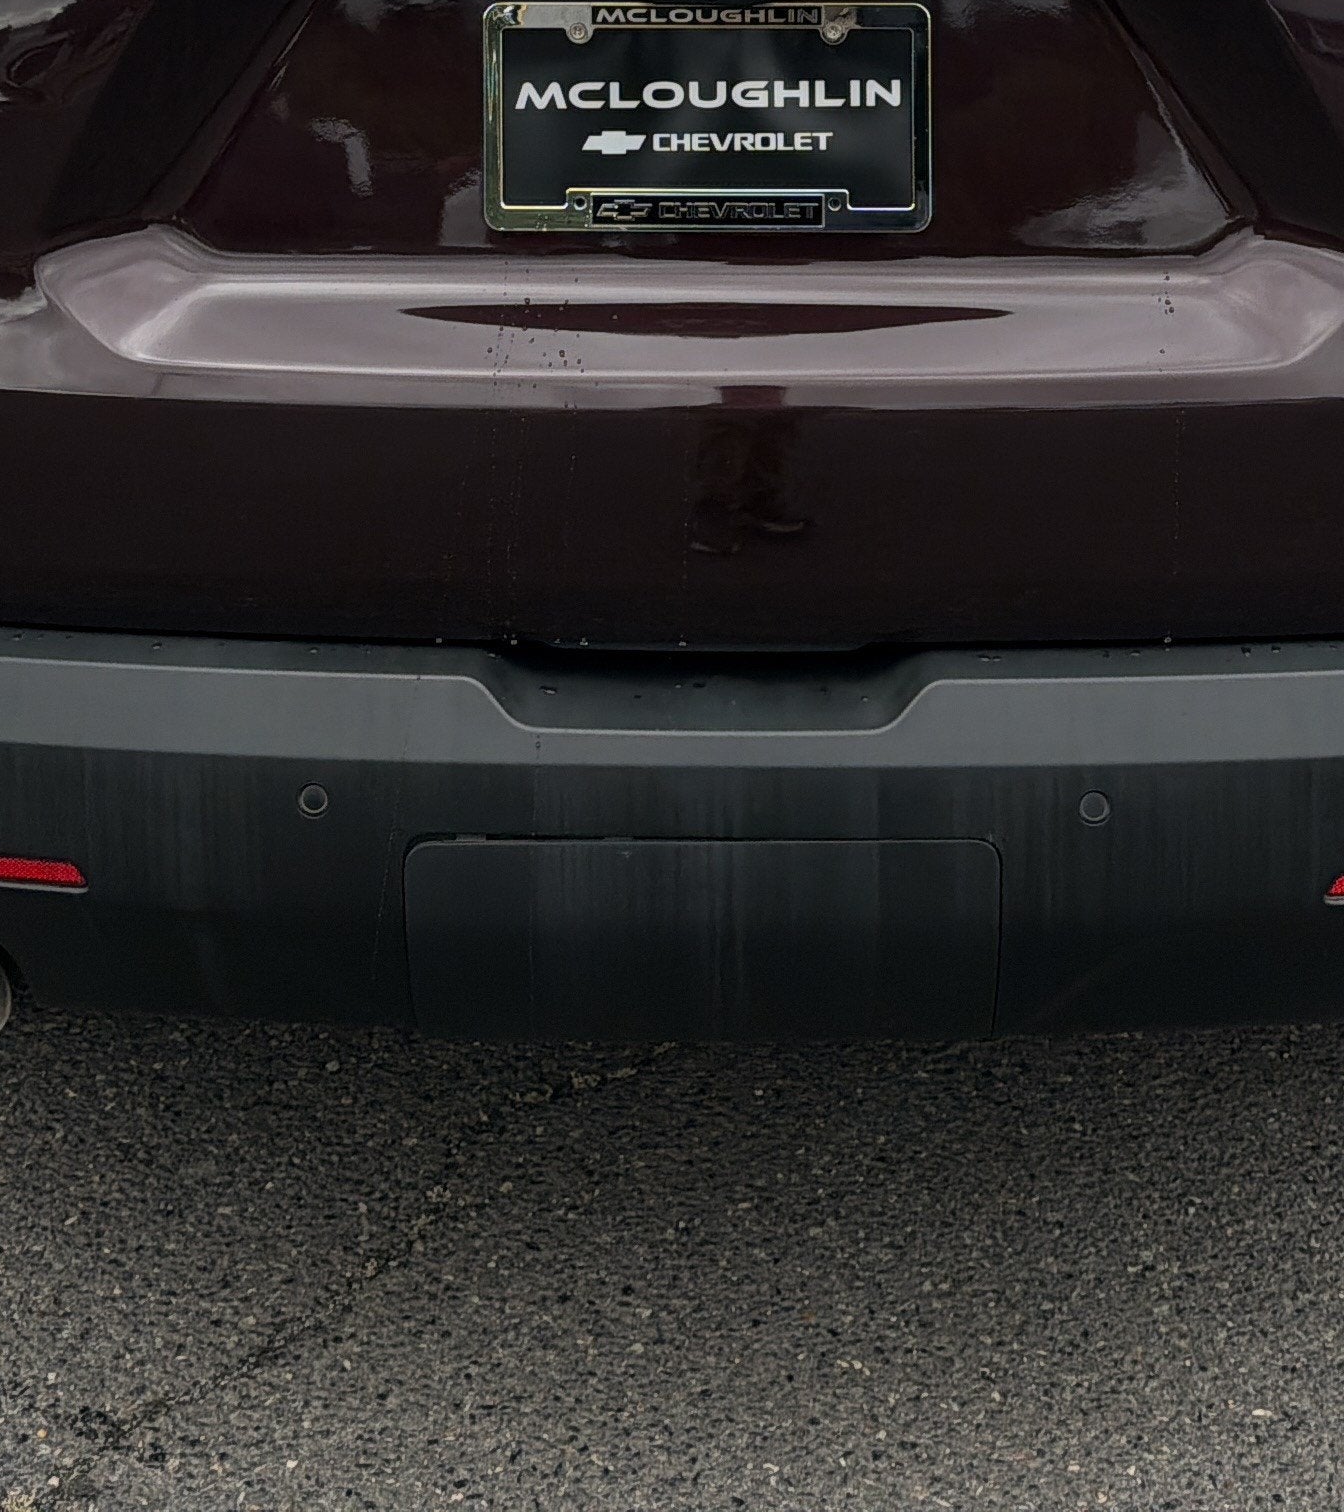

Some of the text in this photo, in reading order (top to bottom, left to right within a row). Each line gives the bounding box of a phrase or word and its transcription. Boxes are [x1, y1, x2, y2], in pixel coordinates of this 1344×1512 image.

[595, 7, 819, 24] MCLOUGHLIN
[515, 79, 901, 110] MCLOUGHLIN
[652, 131, 834, 152] CHEVROLET
[658, 201, 820, 219] CHEVROLET
